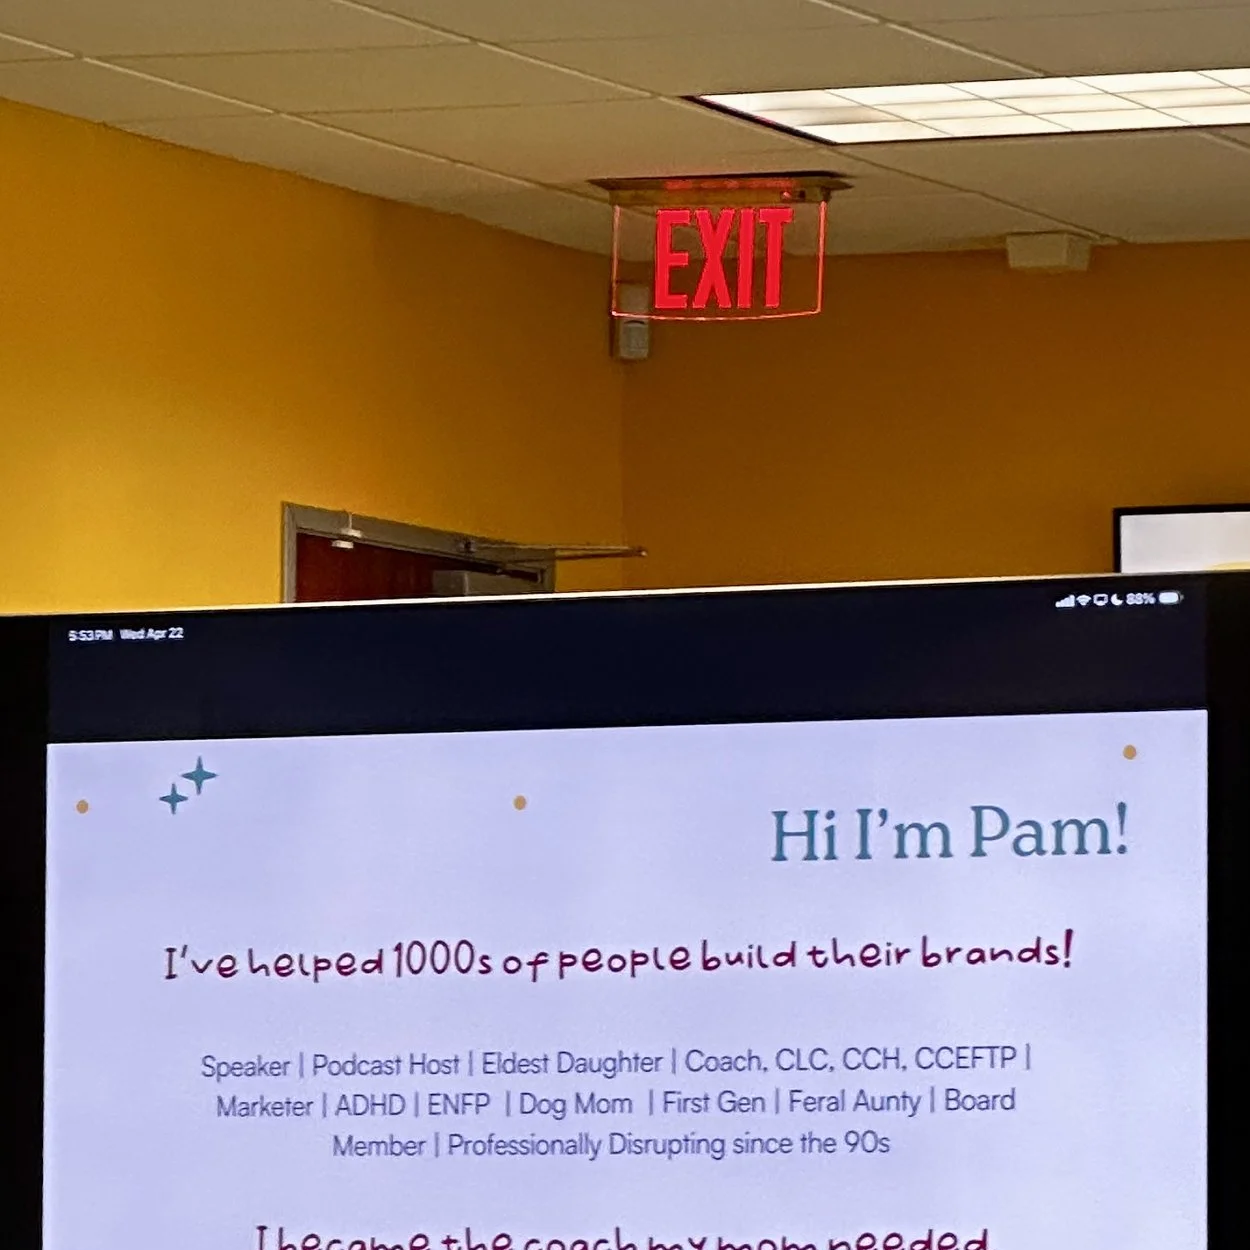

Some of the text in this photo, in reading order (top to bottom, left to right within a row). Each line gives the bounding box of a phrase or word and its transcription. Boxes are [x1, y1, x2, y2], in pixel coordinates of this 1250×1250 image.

[654, 207, 794, 309] EXIT
[168, 627, 184, 639] 22
[771, 801, 1128, 862] Hi I'm Pam!
[164, 928, 1074, 984] I've helped 1000s of people build their brands!
[200, 1054, 292, 1084] Speaker
[312, 1052, 403, 1077] Podcast
[409, 1052, 461, 1076] Host
[481, 1051, 551, 1075] Eldest
[556, 1049, 665, 1080] Daughter
[684, 1048, 769, 1074] Coach,
[774, 1047, 836, 1073] CLC,
[842, 1046, 908, 1072] CCH,
[914, 1045, 1018, 1071] CCEFTP
[216, 1094, 315, 1118] Marketer
[334, 1092, 407, 1117] ADHD
[427, 1092, 492, 1116] ENFP
[519, 1091, 568, 1121] Dog
[574, 1091, 634, 1115] Mom
[662, 1090, 711, 1114] First
[716, 1089, 767, 1114] Gen
[788, 1088, 846, 1113] Feral
[852, 1088, 923, 1118] Aunty
[944, 1087, 1016, 1112] Board
[332, 1133, 428, 1157] Member
[447, 1131, 603, 1162] Professionally
[608, 1131, 726, 1161] Disrupting
[732, 1130, 794, 1155] since
[799, 1130, 838, 1154] the
[843, 1129, 891, 1154] 90s
